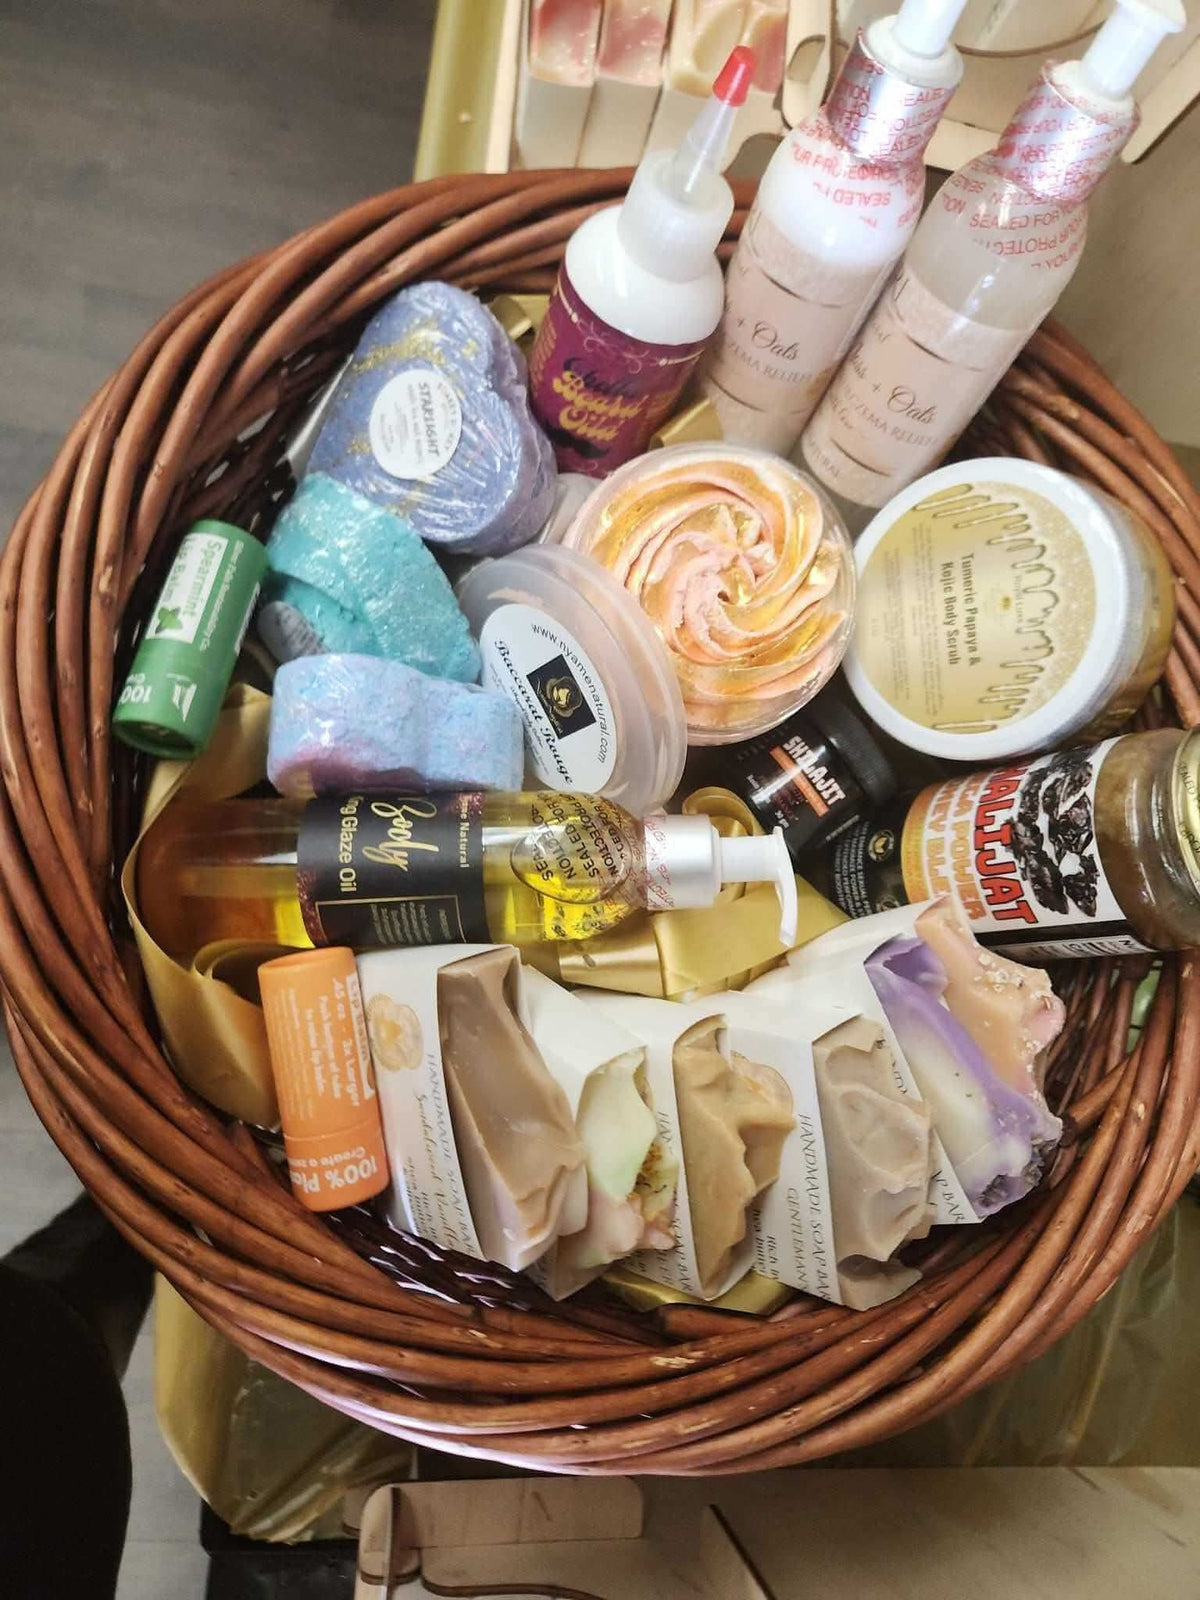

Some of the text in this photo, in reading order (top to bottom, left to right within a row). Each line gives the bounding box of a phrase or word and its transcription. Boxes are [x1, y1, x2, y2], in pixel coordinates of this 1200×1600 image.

[184, 538, 223, 618] Spearmint
[940, 561, 960, 666] Kojic Body Scrub
[963, 606, 979, 656] Papaya
[494, 640, 543, 722] Baccarat
[540, 727, 573, 785] Rouge
[783, 735, 847, 807] SHILAJIT
[338, 816, 359, 864] Glaze
[458, 821, 471, 869] Natural
[529, 804, 577, 881] ROTECTION
[565, 823, 601, 879] SEALED
[950, 819, 987, 922] POWER
[338, 867, 357, 893] Oil
[325, 1157, 378, 1190] 100%
[798, 1113, 821, 1214] HANDMADE
[809, 1220, 826, 1268] SOAP
